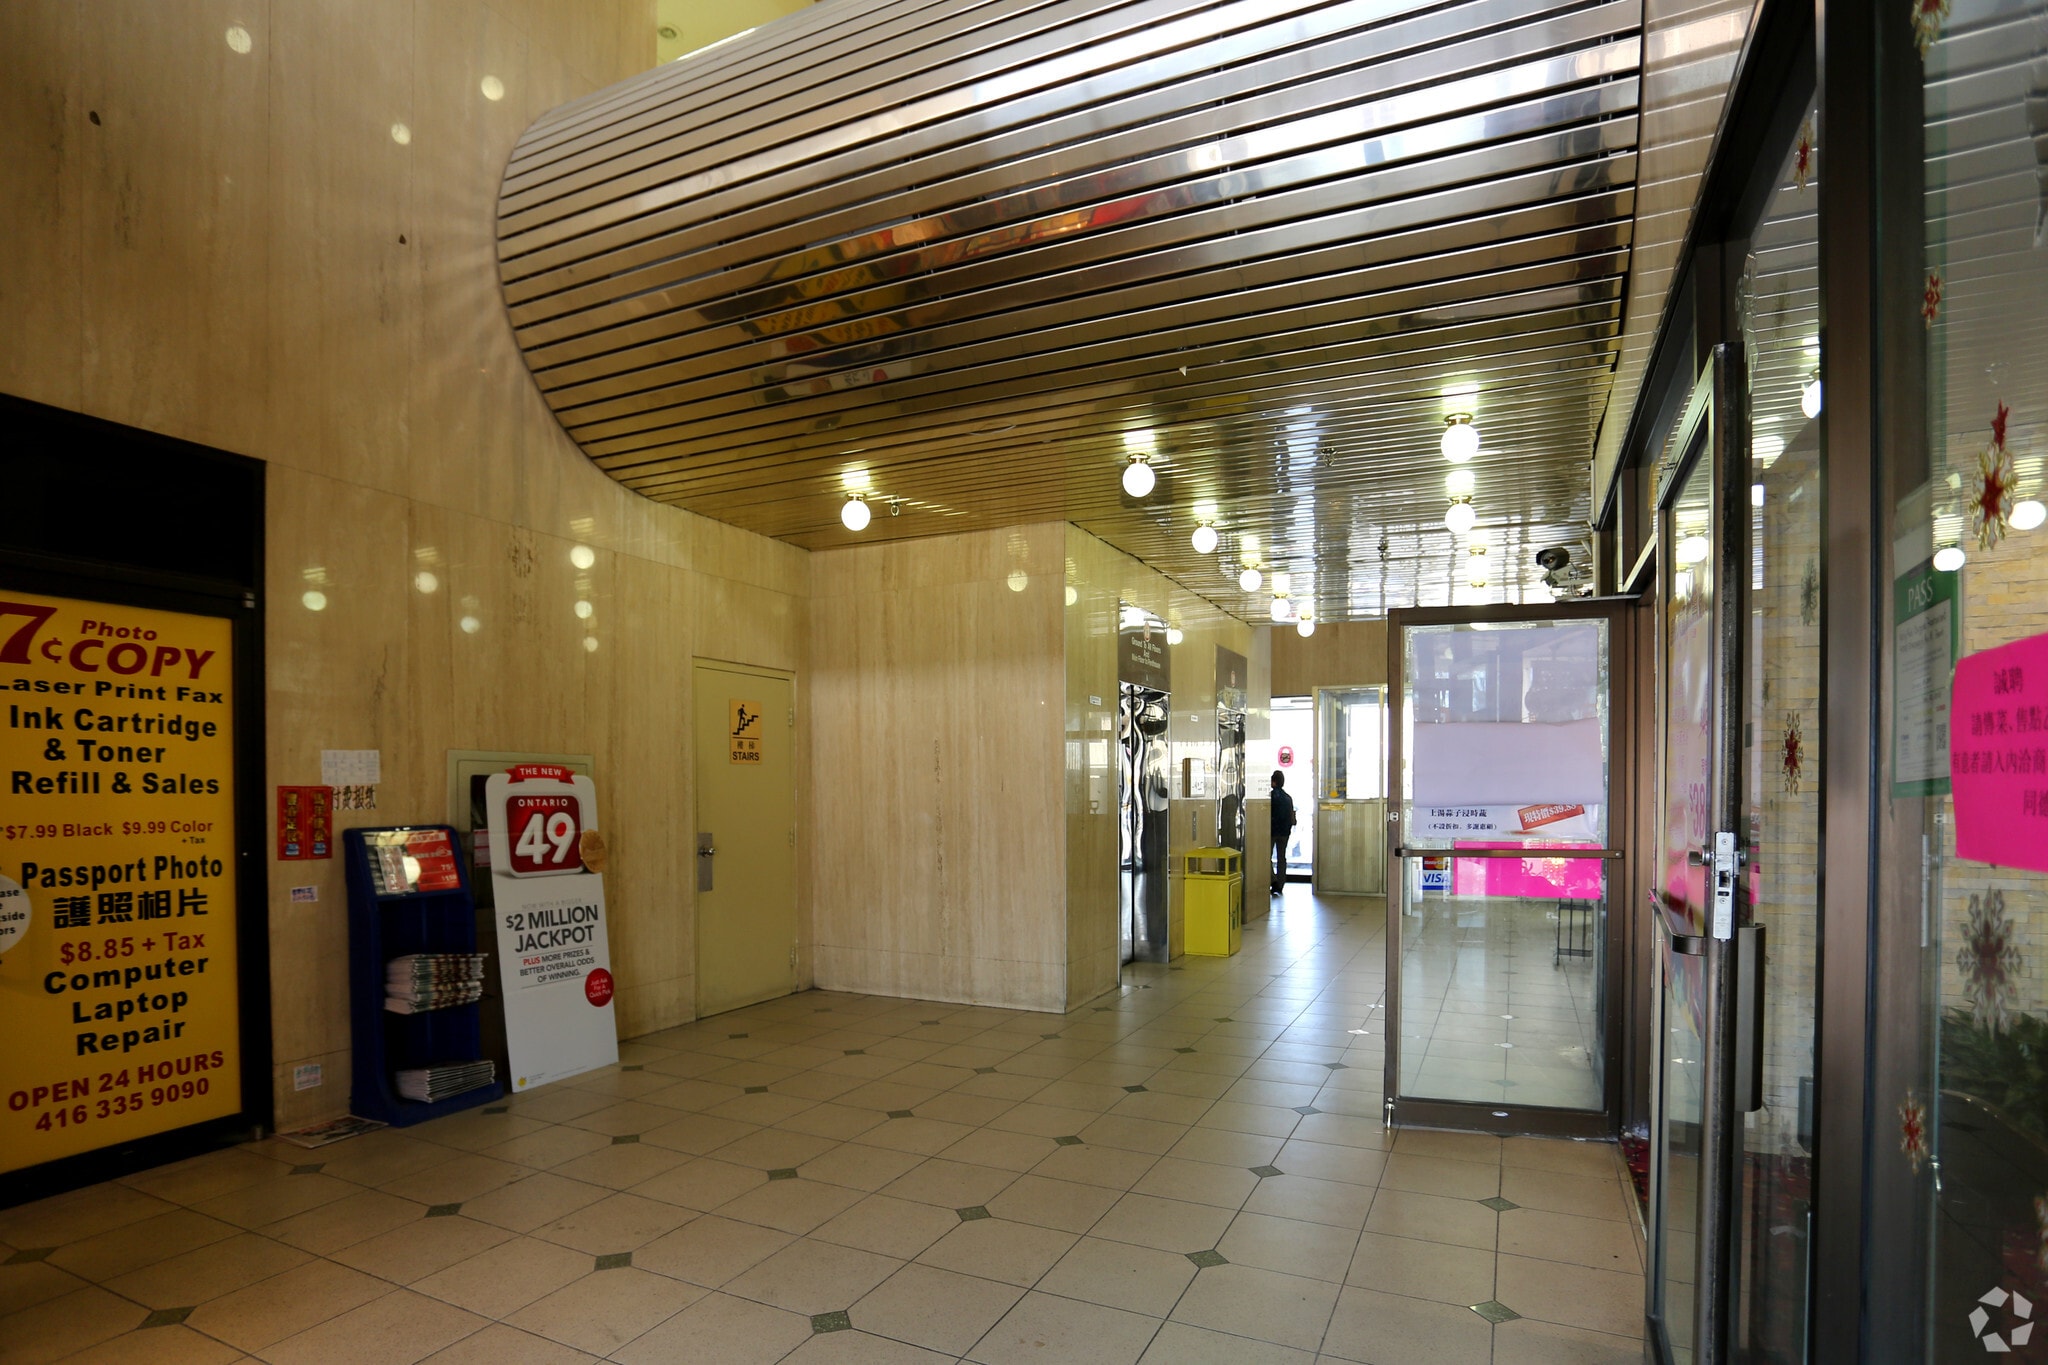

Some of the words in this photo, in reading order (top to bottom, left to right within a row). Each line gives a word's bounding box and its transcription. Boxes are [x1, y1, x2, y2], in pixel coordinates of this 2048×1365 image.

[1908, 576, 1933, 612] PASS
[81, 619, 158, 641] Photo
[69, 639, 216, 680] COPY
[0, 679, 86, 695] aser
[95, 681, 167, 700] Print
[176, 687, 223, 704] Fax
[10, 705, 64, 730] Ink
[74, 708, 217, 741] Cartridge
[44, 738, 67, 761] &
[77, 739, 166, 763] Toner
[732, 751, 759, 761] STAIRS
[11, 771, 100, 794] Refill
[111, 772, 132, 794] &
[142, 772, 220, 795] Sales
[541, 768, 562, 776] NEW
[518, 799, 568, 807] ONTARIO
[6, 825, 57, 840] $7.99
[63, 823, 113, 838] Black
[122, 821, 166, 836] $9.99
[170, 820, 213, 834] Color
[189, 836, 206, 844] Tax
[515, 812, 575, 865] 49
[21, 857, 147, 891] Passport
[154, 855, 223, 880] Photo
[53, 888, 208, 929] 護照相片
[505, 913, 525, 931] $2
[528, 904, 599, 929] MILLION
[60, 936, 135, 966] $8.85
[142, 938, 156, 951] +
[163, 932, 206, 951] Tax
[515, 925, 594, 953] JACKPOT
[520, 965, 545, 976] BETTER
[546, 961, 576, 971] OVERALL
[577, 957, 595, 965] ODDS
[523, 957, 541, 966] PLUS
[541, 953, 562, 962] MORE
[563, 950, 584, 958] PRIZES
[44, 957, 209, 994] Computer
[537, 975, 547, 983] OF
[73, 990, 188, 1024] Laptop
[77, 1019, 186, 1056] Repair
[8, 1077, 90, 1111] OPEN
[98, 1069, 130, 1093] 24
[137, 1050, 225, 1085] HOURS
[35, 1104, 87, 1132] 416
[96, 1092, 143, 1119] 335
[151, 1078, 209, 1106] 9090
